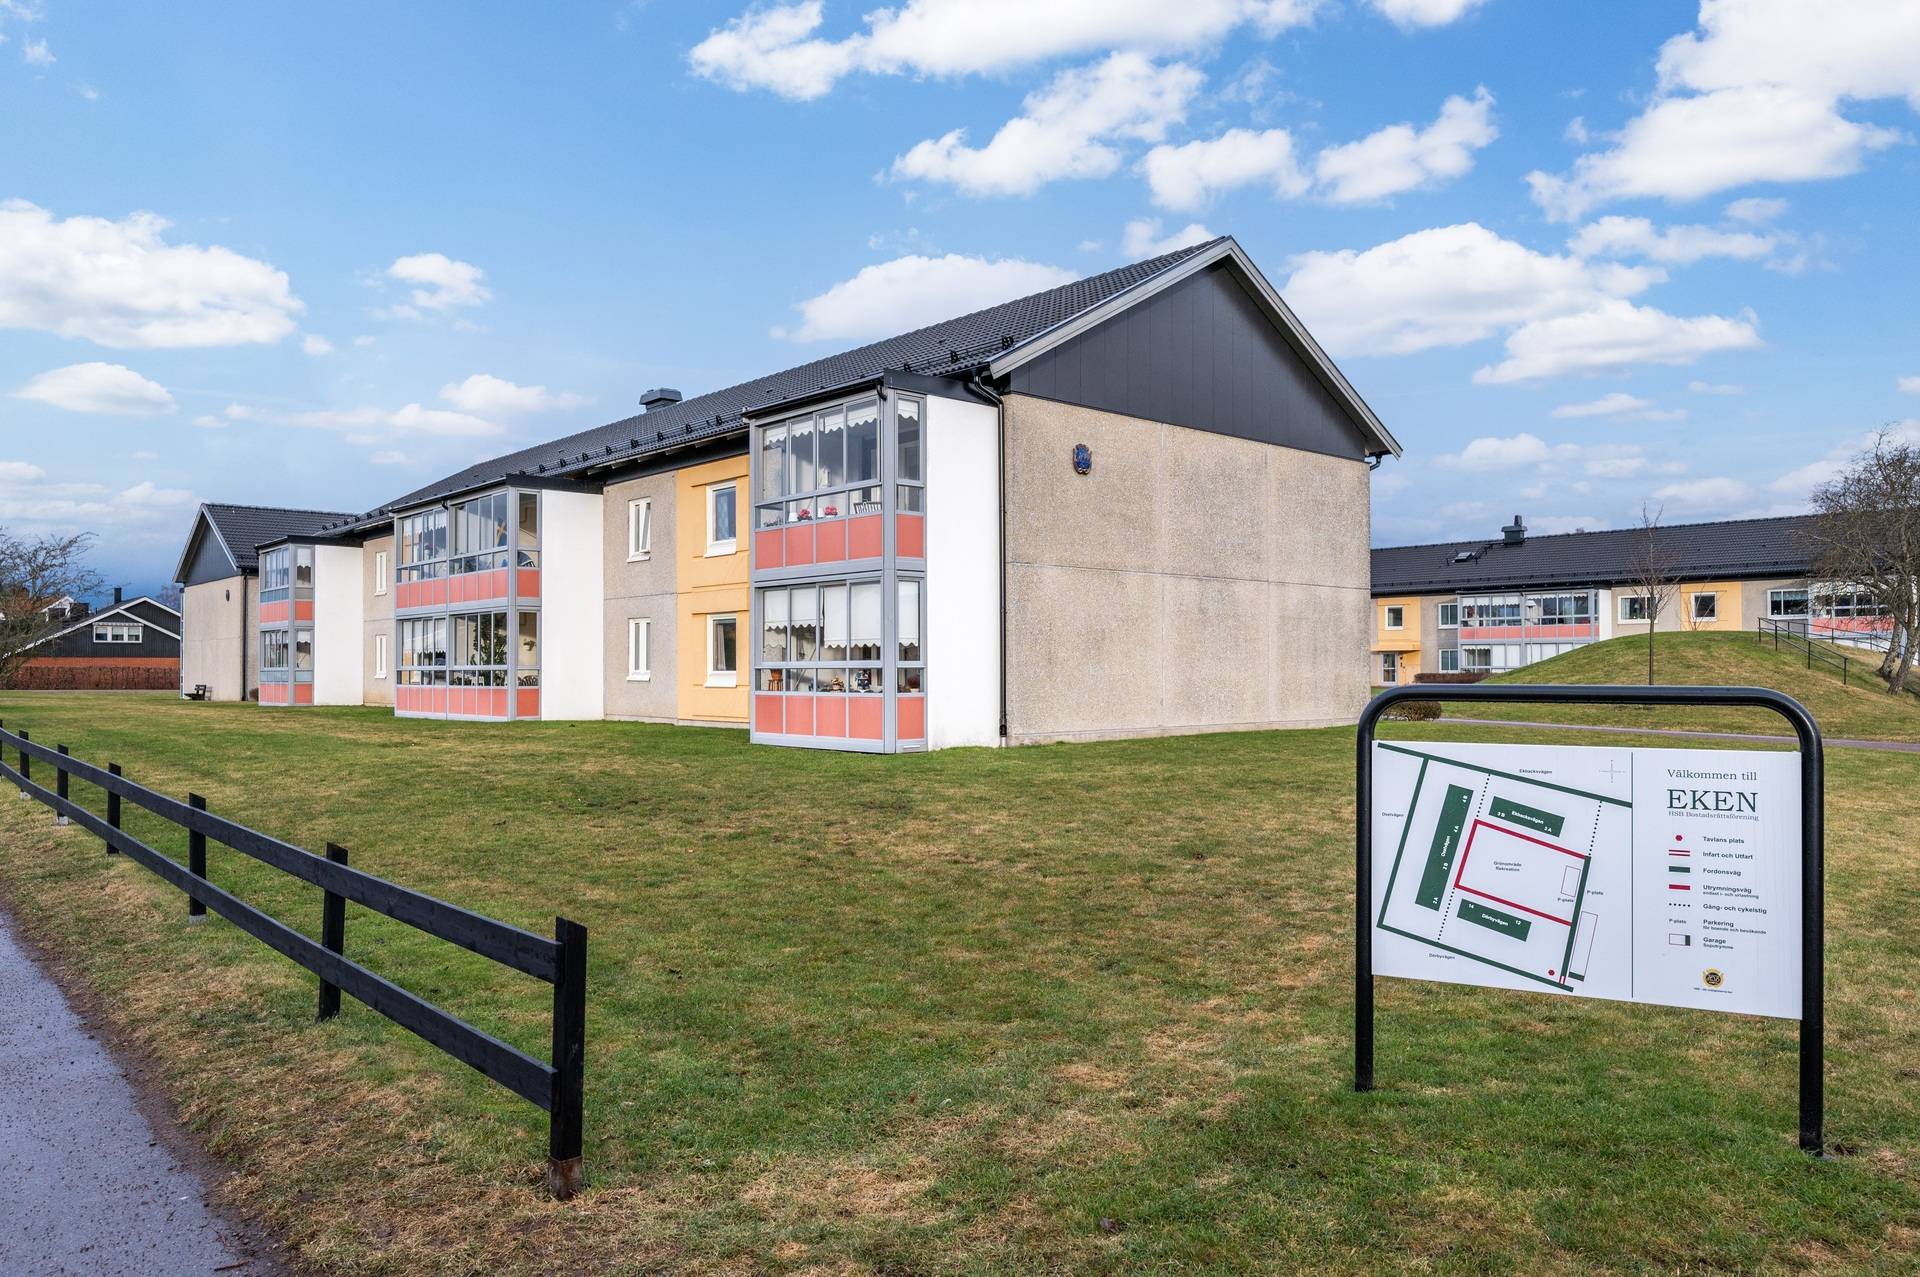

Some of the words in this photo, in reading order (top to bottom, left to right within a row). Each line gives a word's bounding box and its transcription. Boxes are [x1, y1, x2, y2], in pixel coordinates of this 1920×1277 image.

[1667, 769, 1737, 780] Välkommen
[1742, 772, 1757, 781] till
[1667, 789, 1758, 813] EKEN
[1686, 812, 1759, 821] Bostadsrättsförening
[1703, 867, 1741, 877] Fordonsväg
[1703, 884, 1752, 894] Utrymningsväg
[1703, 903, 1723, 911] Gång-
[1703, 919, 1734, 928] Parkering
[1703, 936, 1727, 945] Garage
